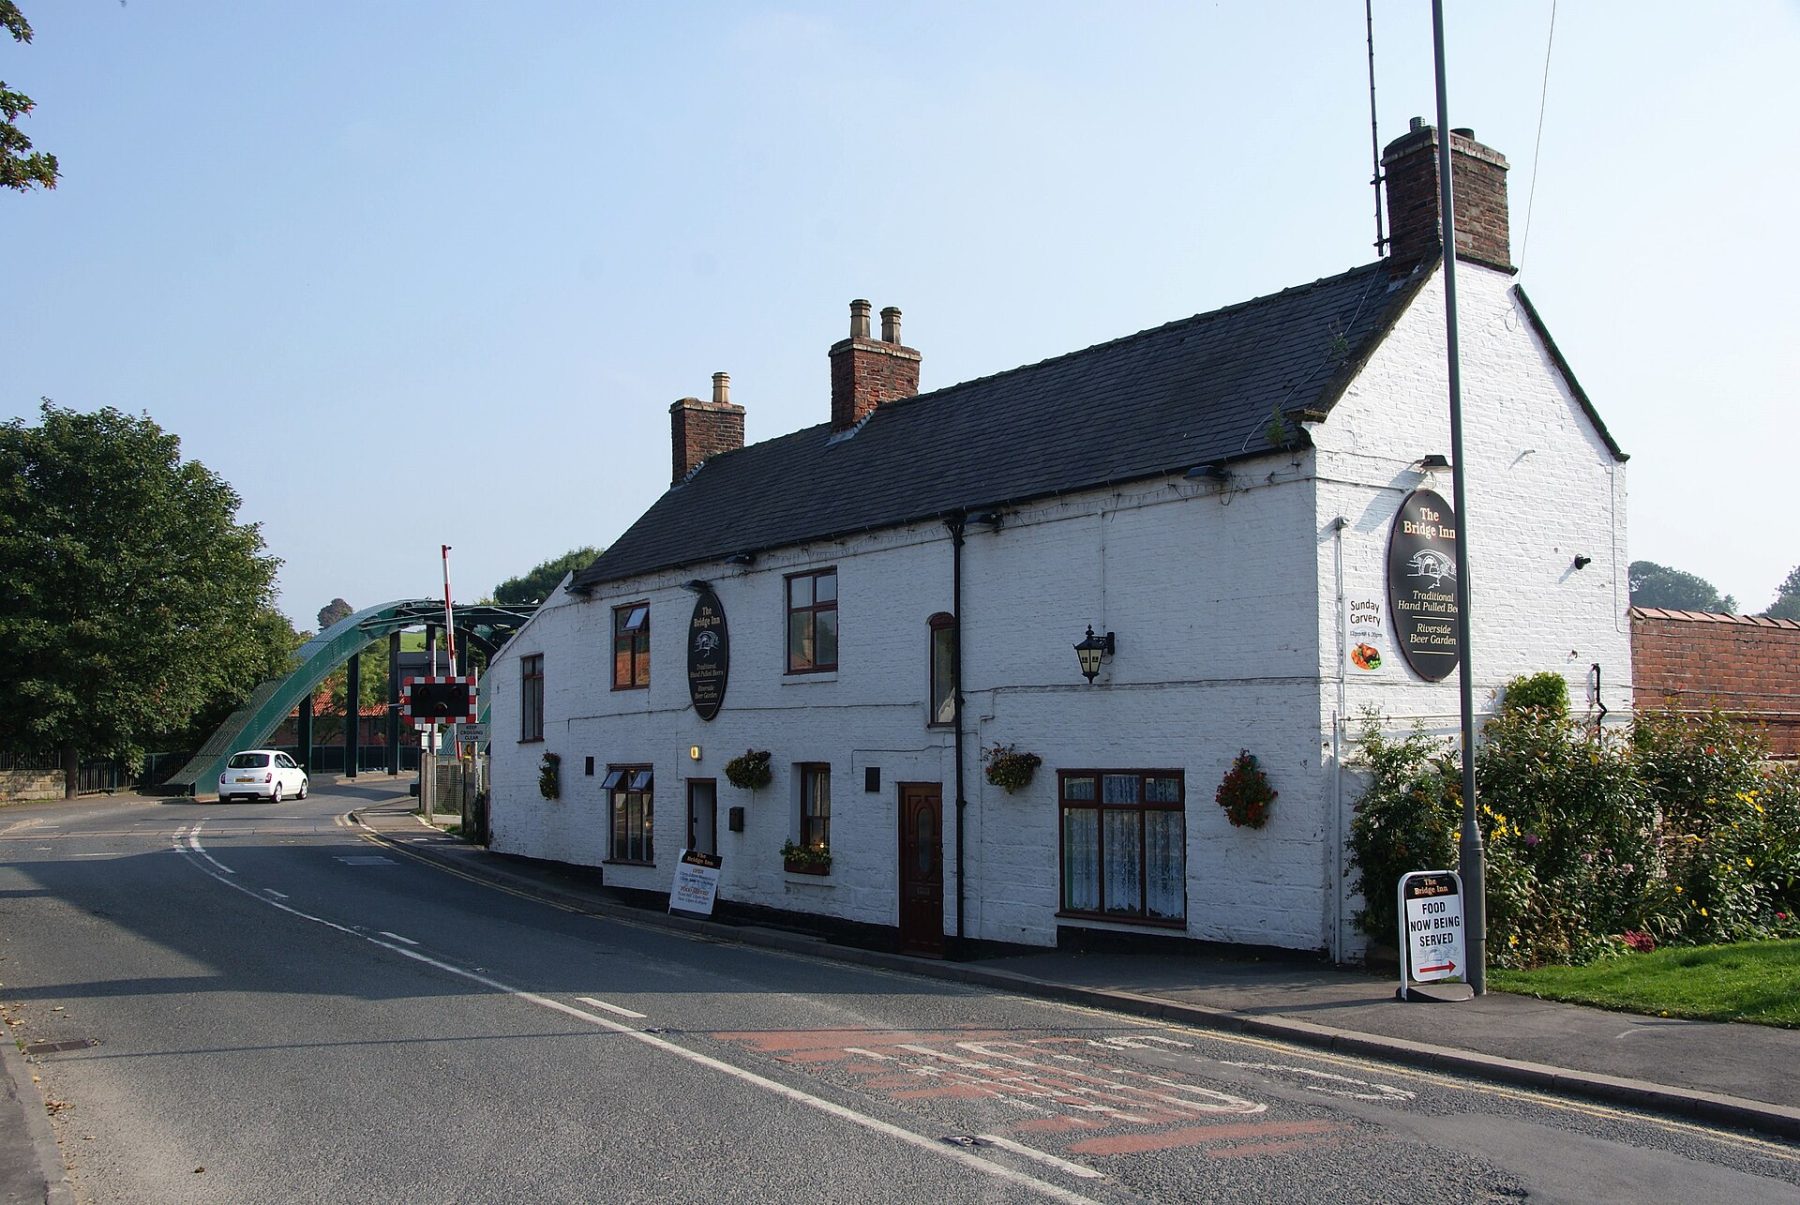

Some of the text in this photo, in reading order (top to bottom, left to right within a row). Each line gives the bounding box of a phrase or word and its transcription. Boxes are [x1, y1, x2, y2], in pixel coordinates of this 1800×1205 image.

[1420, 507, 1440, 521] The
[1403, 521, 1456, 540] Bridge Inn
[1413, 590, 1454, 602] Traditional
[702, 606, 712, 615] The
[1350, 598, 1380, 614] Sunday
[1398, 600, 1420, 611] Hand
[1422, 602, 1446, 613] Pulled
[694, 616, 720, 629] Bridge Inn
[1350, 613, 1381, 628] Carvery
[1417, 623, 1452, 634] Riverside
[1410, 633, 1457, 645] Beer Garden
[1414, 885, 1448, 896] Bridge Inn
[1422, 902, 1446, 914] FOOD
[1411, 916, 1460, 932] NOW BEING
[1420, 933, 1454, 947] SERVED
